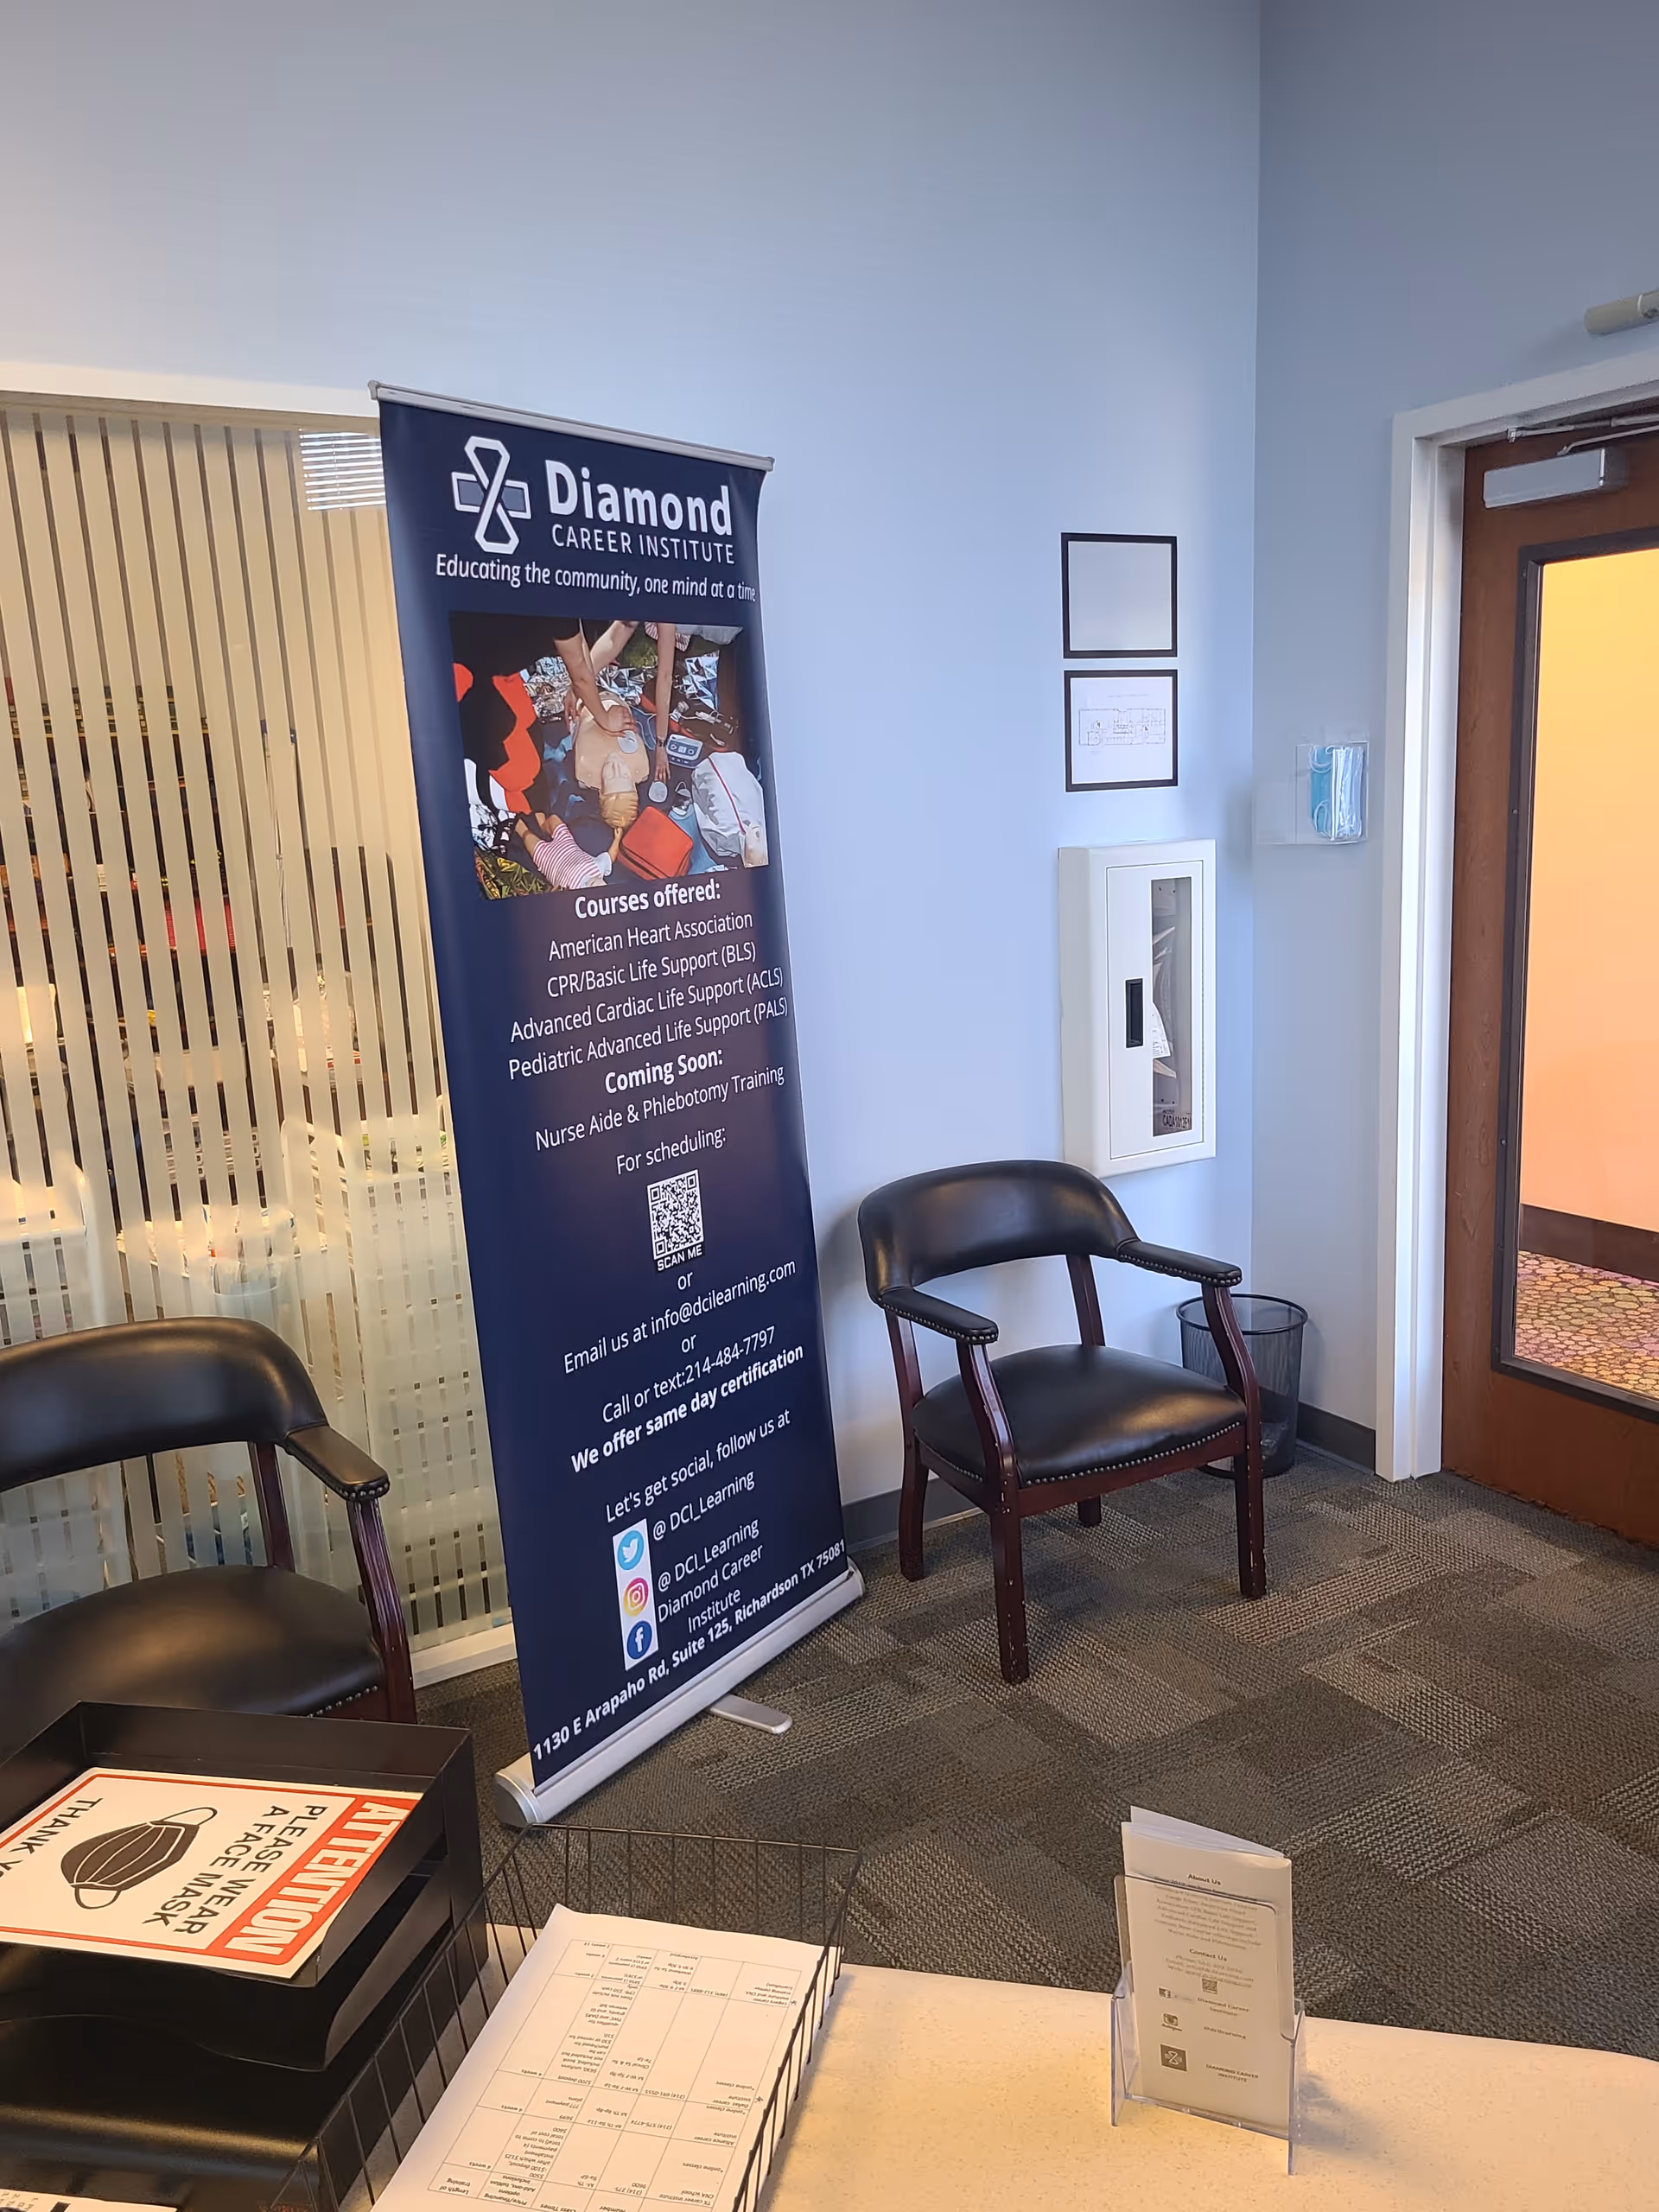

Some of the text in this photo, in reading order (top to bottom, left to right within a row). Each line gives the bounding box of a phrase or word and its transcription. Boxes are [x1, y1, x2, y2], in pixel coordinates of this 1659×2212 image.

[545, 460, 732, 536] Diamond
[552, 524, 734, 564] CAREER INSTITUTE
[436, 553, 756, 602] Educating the community, one mind at a time
[575, 878, 721, 918] Courses offered:
[550, 912, 753, 961] American Heart Association
[548, 942, 755, 997] CPR/Basic Life Support (BLS)
[511, 967, 783, 1042] Advanced Cardiac Life Support (ACLS)
[509, 997, 788, 1080] Pediatric Advanced Life Support (PALS)
[605, 1049, 722, 1093] Coming Soon:
[536, 1066, 785, 1151] Nurse Aide & Phlebotomy Training
[617, 1128, 726, 1175] For scheduling:
[657, 1244, 702, 1271] SCAN ME
[677, 1272, 693, 1290] or
[564, 1262, 795, 1374] Email us at info@dcilearning.com
[682, 1334, 696, 1353] or
[603, 1325, 774, 1422] Call or text:214-484-7797
[571, 1346, 804, 1472] We offer same day certification
[607, 1409, 790, 1522] Let's get social, follow us at
[653, 1471, 754, 1541] @ DCI_Learning
[658, 1519, 759, 1592] @ DCI_Learning
[658, 1545, 762, 1623] Diamond Career
[688, 1589, 741, 1633] Institute
[534, 1539, 844, 1760] 1130 E Arapaho Rd, Suite 125, Richardson TX 75081
[9, 1797, 104, 1854] THANK
[142, 1805, 290, 1927] A FACE MASK
[173, 1804, 328, 1935] PLEASE WEAR
[224, 1801, 410, 1955] ATTENTION
[1187, 1873, 1211, 1884] About
[1189, 1948, 1216, 1959] Contact
[447, 2178, 470, 2187] training
[484, 2193, 527, 2205] Price/financing
